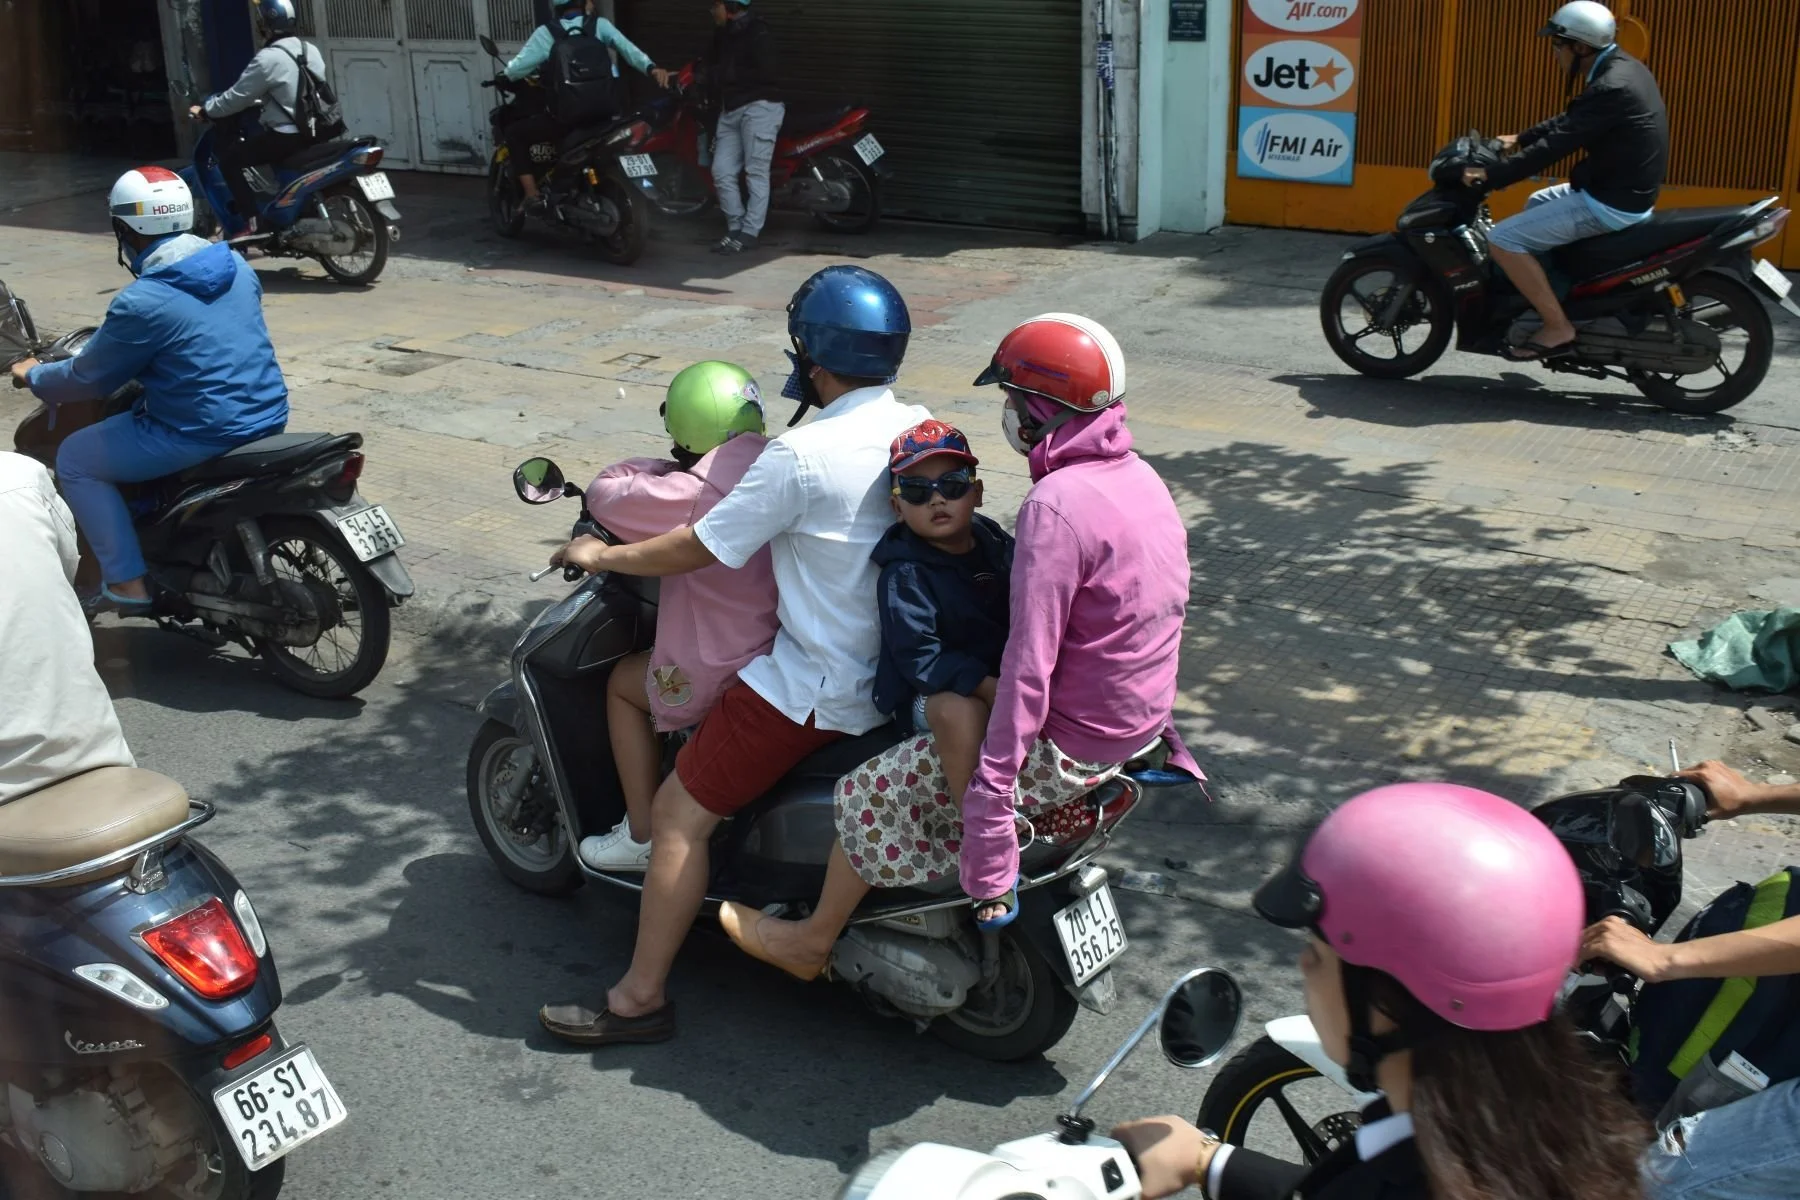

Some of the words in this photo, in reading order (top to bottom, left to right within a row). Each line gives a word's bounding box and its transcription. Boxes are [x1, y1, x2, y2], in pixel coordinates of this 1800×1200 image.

[1253, 56, 1310, 90] Jet
[1269, 135, 1307, 155] FMI
[1310, 138, 1343, 158] Air
[152, 203, 190, 215] HDBank
[1630, 267, 1670, 287] YAMAHA
[358, 528, 398, 555] 3255
[1065, 892, 1107, 943] 70-L1
[1071, 919, 1122, 977] 356.25
[65, 1029, 146, 1054] Vespa
[233, 1060, 306, 1121] 66-S1
[241, 1087, 332, 1161] 234.87
